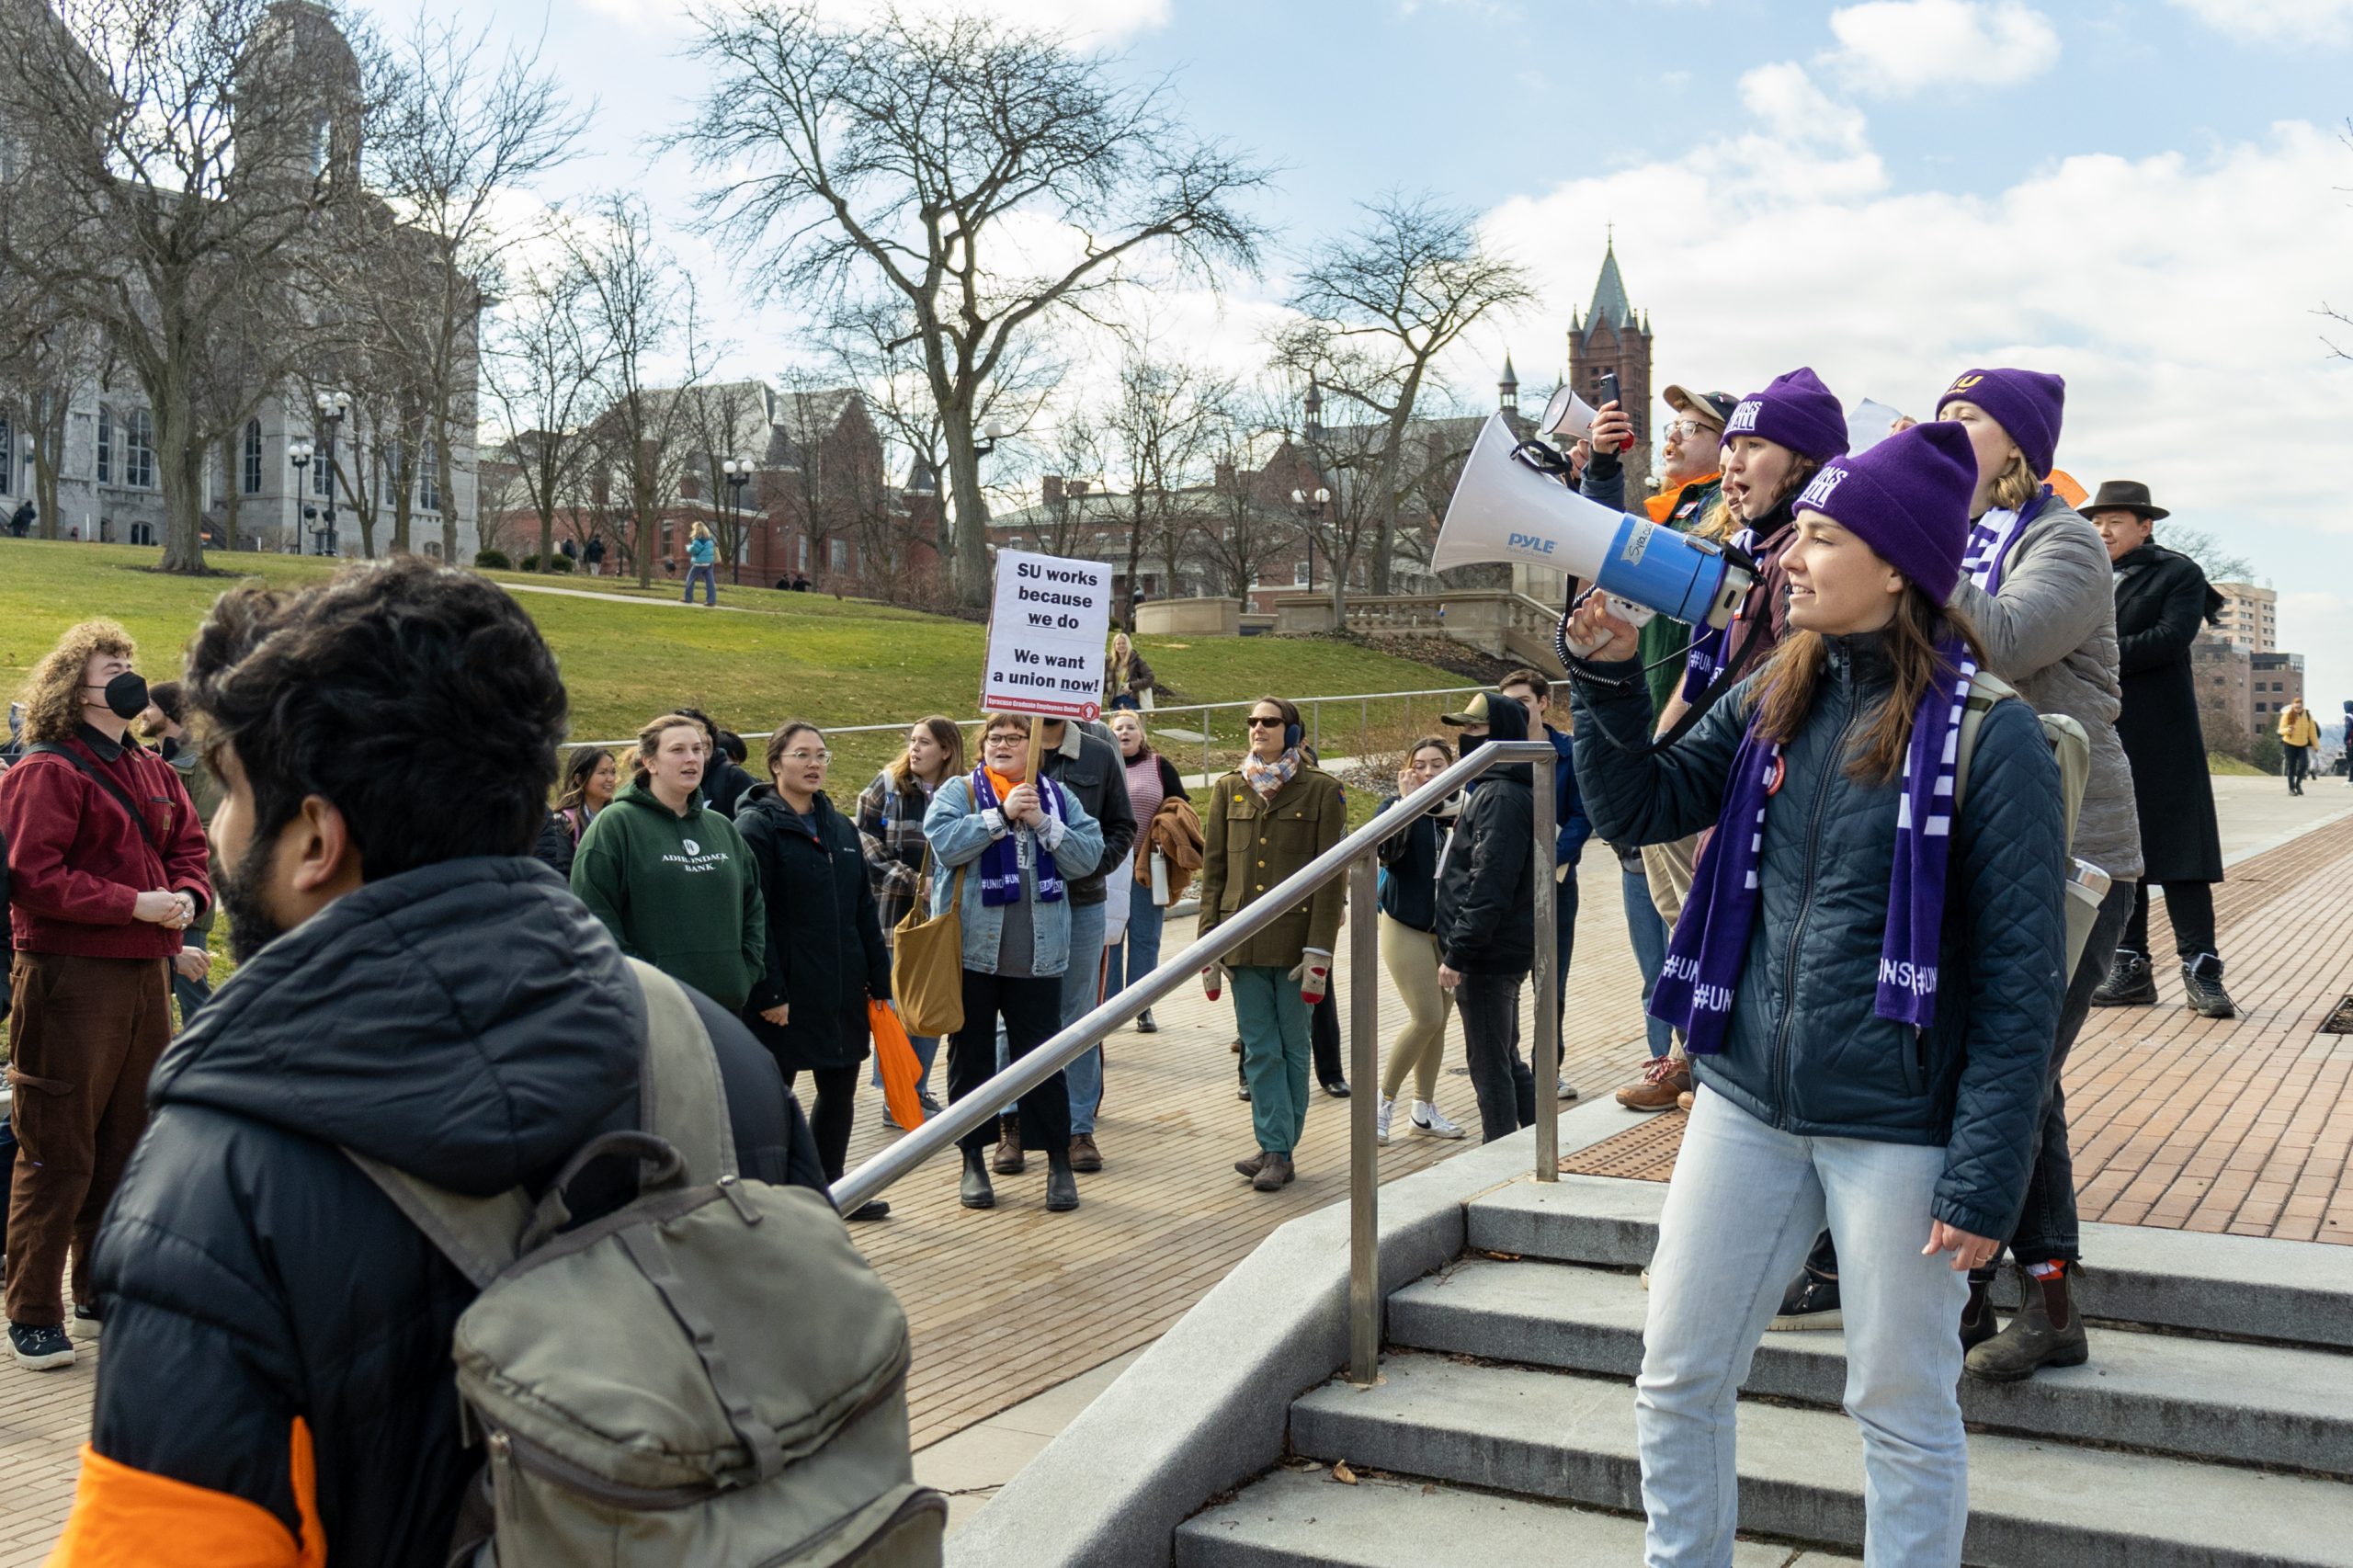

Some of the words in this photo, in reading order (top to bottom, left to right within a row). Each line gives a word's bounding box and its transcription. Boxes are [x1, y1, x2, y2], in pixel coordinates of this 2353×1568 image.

[1508, 532, 1555, 554] PYLE
[1017, 562, 1041, 579] SU
[1046, 570, 1097, 586] works
[1018, 585, 1093, 608] because
[1028, 612, 1053, 627] we
[1057, 614, 1079, 630] do
[1014, 648, 1040, 665] We
[1045, 653, 1086, 670] want
[993, 671, 1004, 683] a
[1008, 672, 1056, 688] union
[1060, 678, 1099, 693] now!
[662, 853, 729, 864] ADIRONDACK
[685, 863, 716, 872] BANK
[1694, 983, 1734, 1012] #UN
